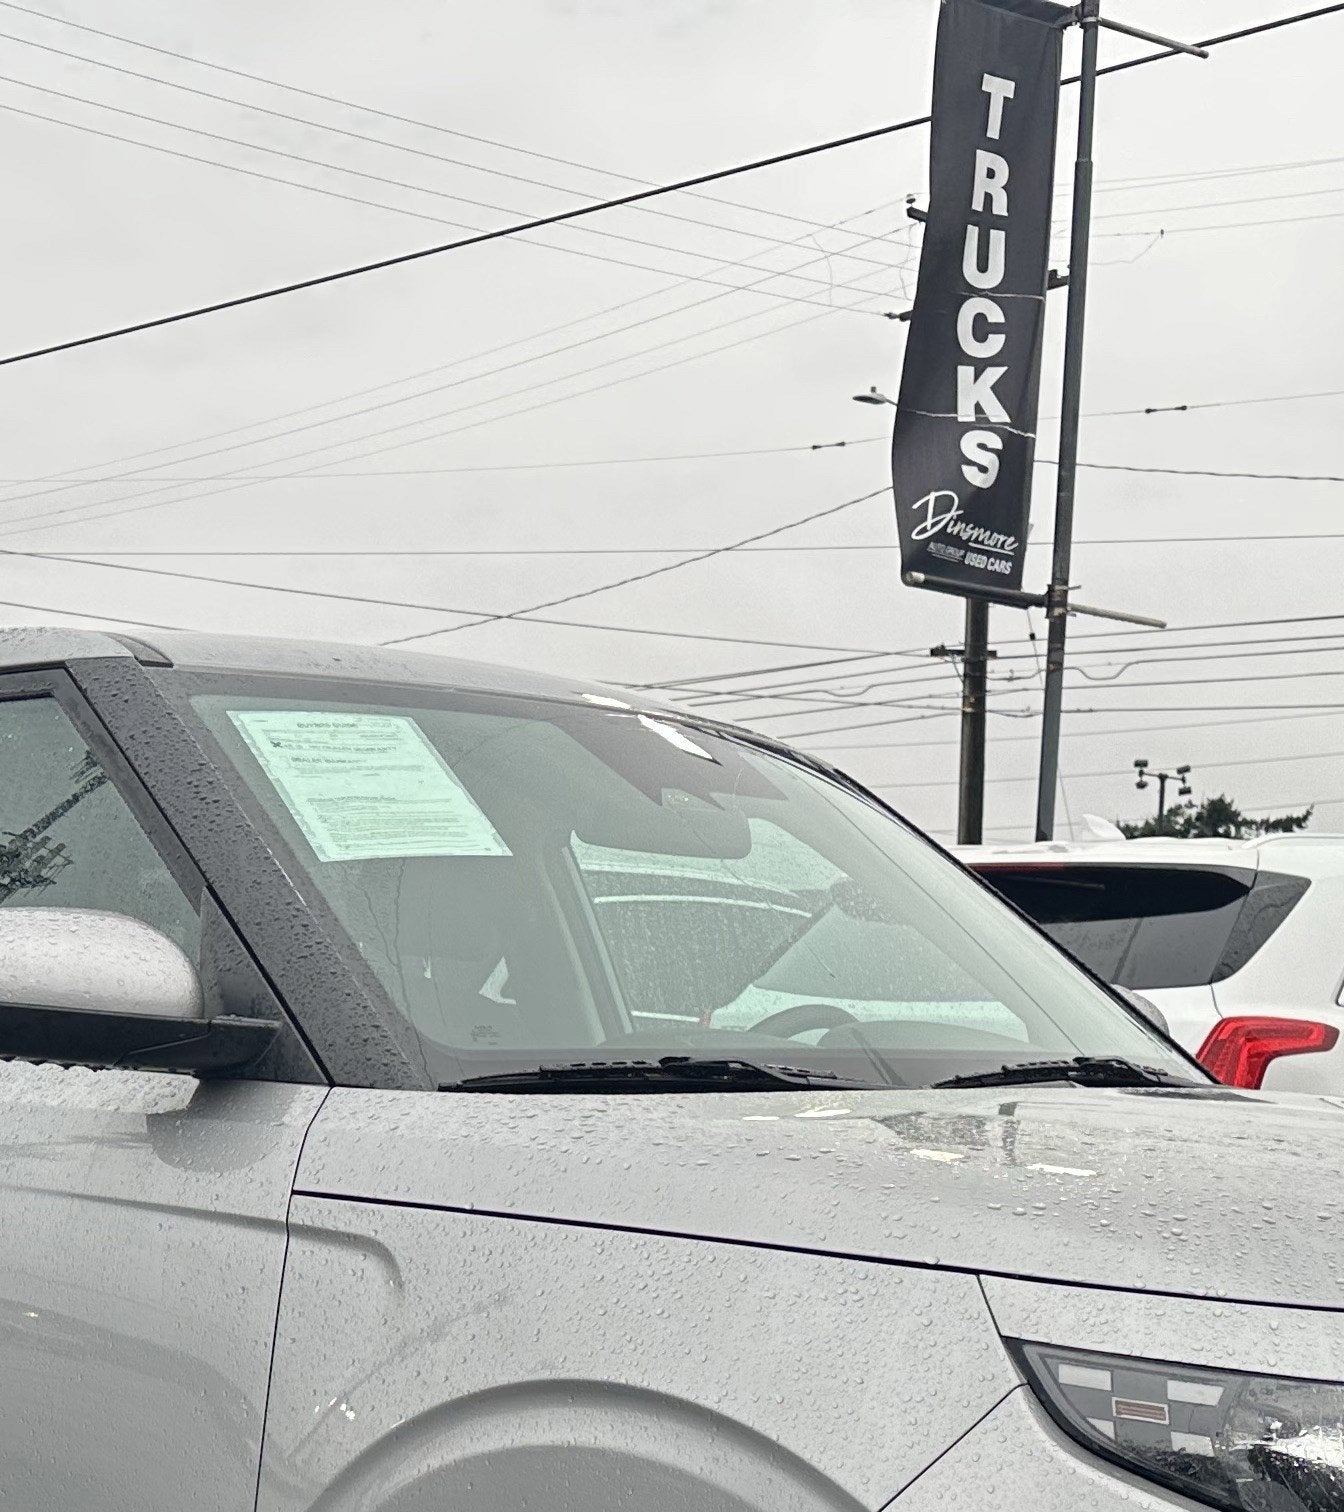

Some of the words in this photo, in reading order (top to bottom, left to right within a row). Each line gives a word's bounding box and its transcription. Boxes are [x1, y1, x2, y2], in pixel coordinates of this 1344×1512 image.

[956, 72, 1015, 490] TRUCKS
[911, 490, 1019, 551] Dinsmore
[964, 551, 988, 569] USED
[987, 557, 1013, 575] CARS
